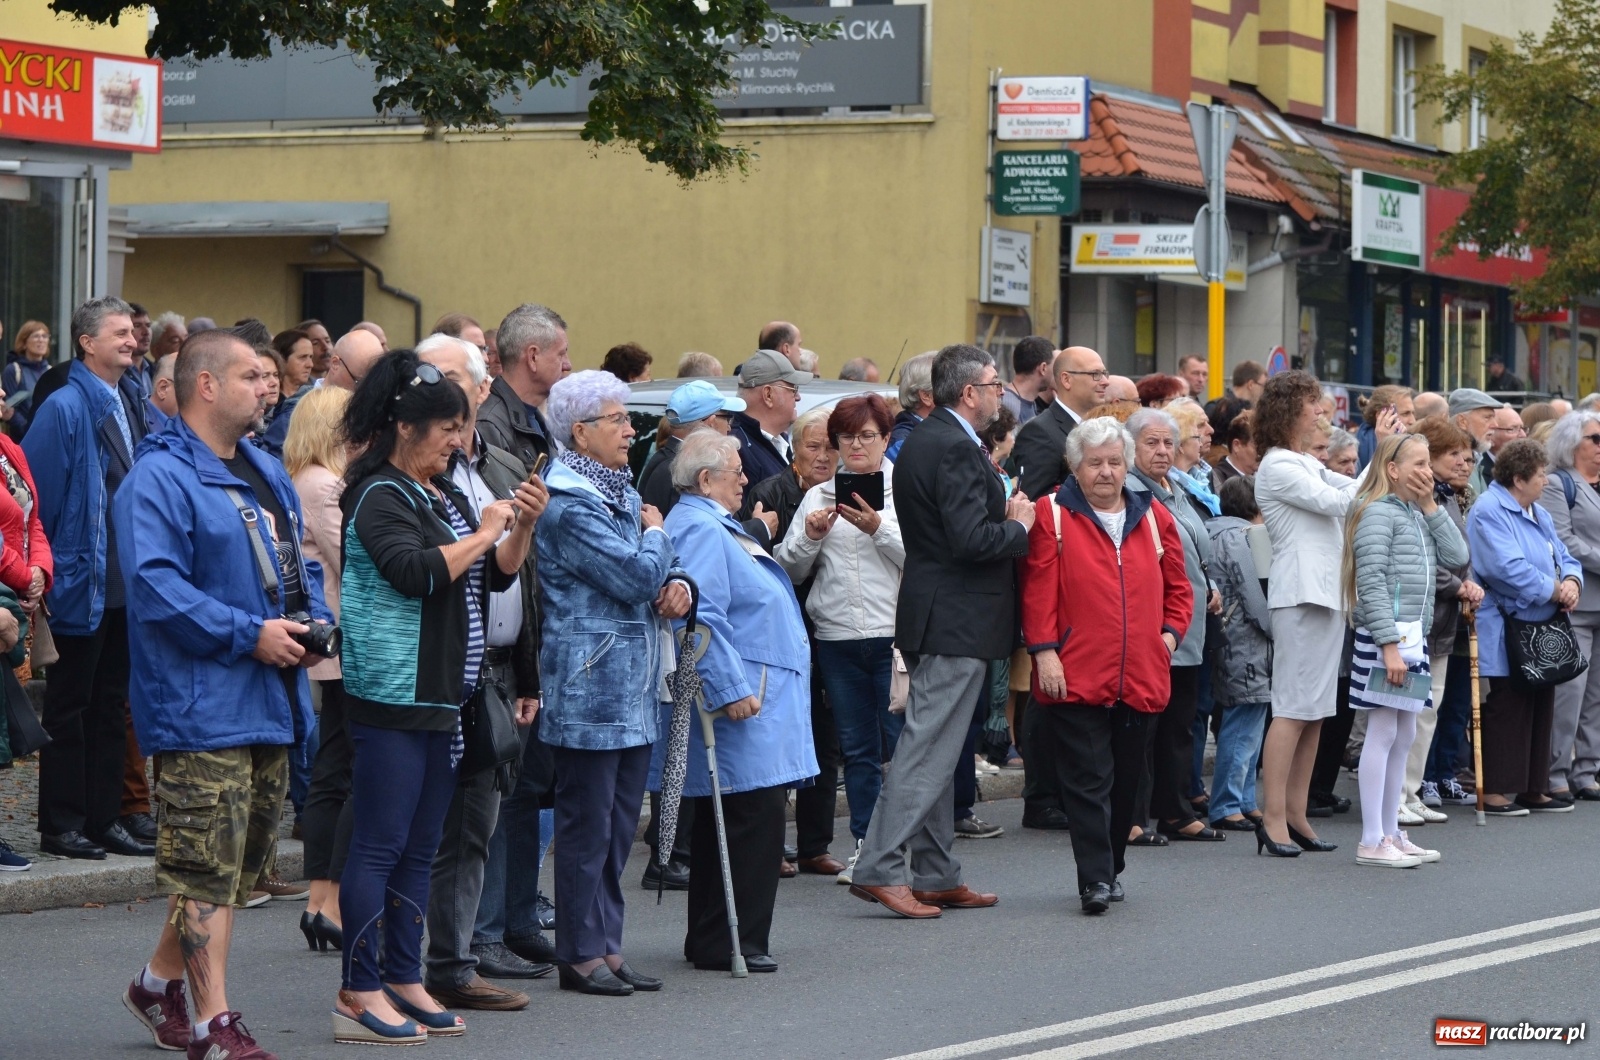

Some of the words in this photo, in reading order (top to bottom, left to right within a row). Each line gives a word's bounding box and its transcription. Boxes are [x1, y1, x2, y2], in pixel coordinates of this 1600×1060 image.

[741, 82, 836, 95] Klimanek-Rychlik
[1027, 86, 1076, 96] Dentica24
[1002, 154, 1069, 165] KANCELARIA
[1003, 167, 1068, 177] ADWOKACKA
[1010, 187, 1022, 195] Jan
[1002, 195, 1030, 204] Szymon
[1155, 234, 1187, 243] SKLEP
[1144, 245, 1194, 255] FIRMOWY
